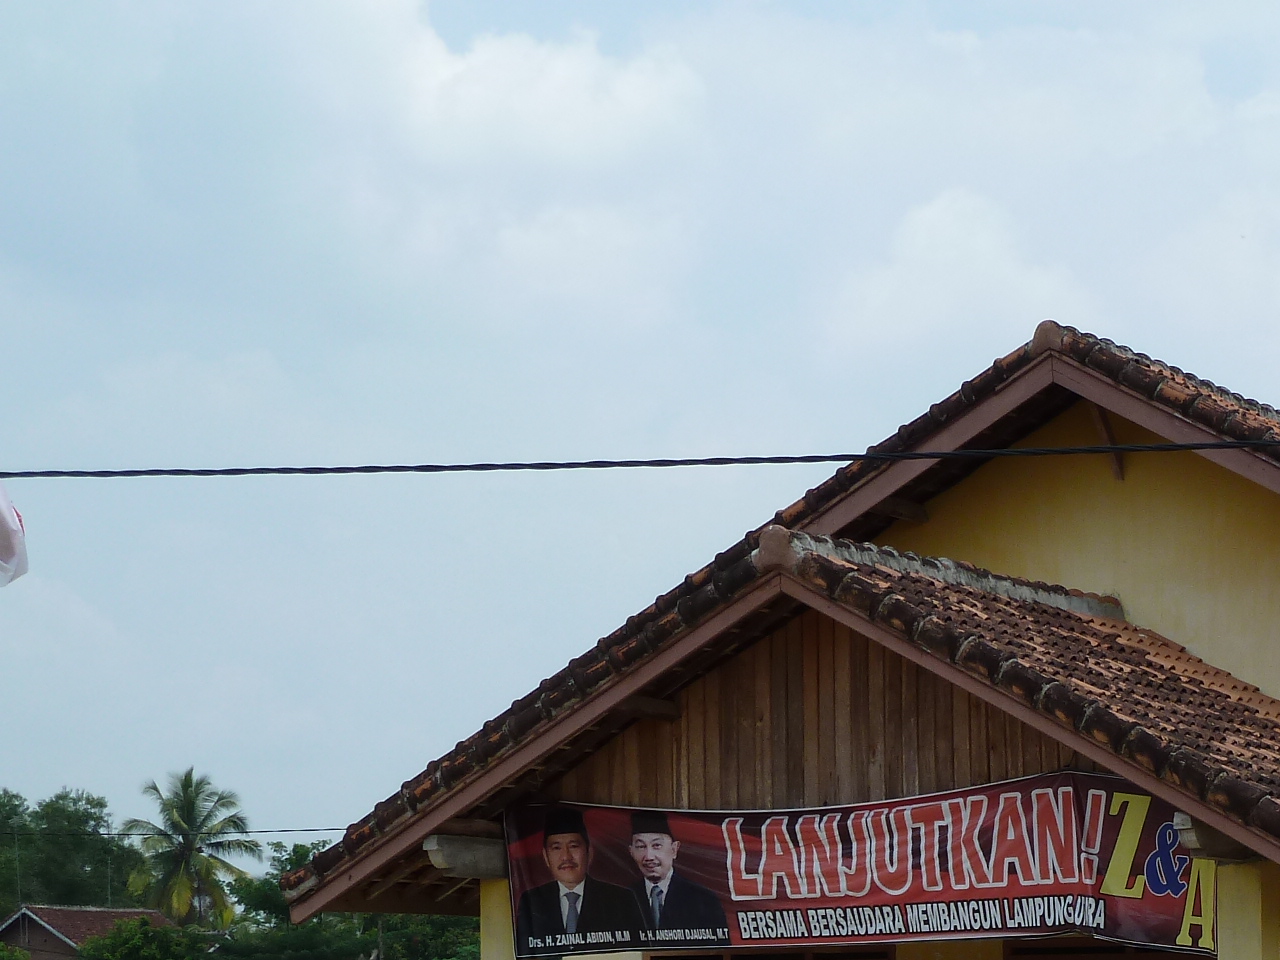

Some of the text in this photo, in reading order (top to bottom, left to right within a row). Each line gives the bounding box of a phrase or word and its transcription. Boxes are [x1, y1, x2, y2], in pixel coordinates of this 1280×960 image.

[721, 786, 1106, 901] LANJUTKAN!
[737, 909, 809, 939] BERSAMA
[807, 904, 906, 937] BERSAUDARA
[905, 899, 1003, 933] MEMBANGUN
[528, 936, 545, 948] Drs.
[545, 935, 555, 946] H.
[555, 933, 586, 946] ZAINAL
[586, 931, 615, 944] ABIDIN,
[647, 930, 656, 941] H.
[655, 929, 685, 941] ANSHORI
[684, 928, 718, 942] DJAUSAL,
